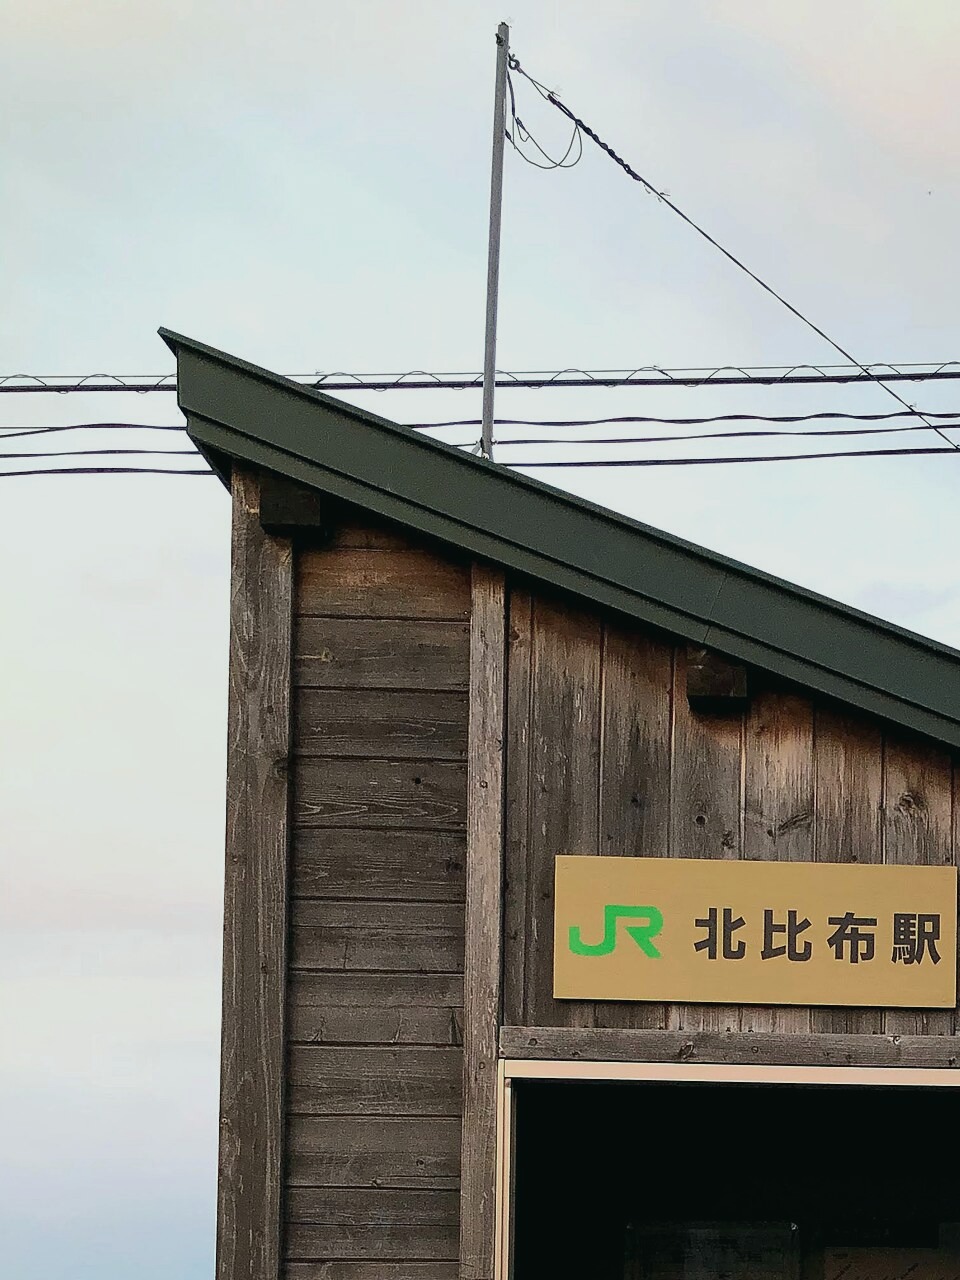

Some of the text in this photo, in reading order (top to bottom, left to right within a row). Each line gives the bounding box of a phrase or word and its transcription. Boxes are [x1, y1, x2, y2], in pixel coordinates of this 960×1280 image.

[568, 904, 942, 966] JR 北比布駅
